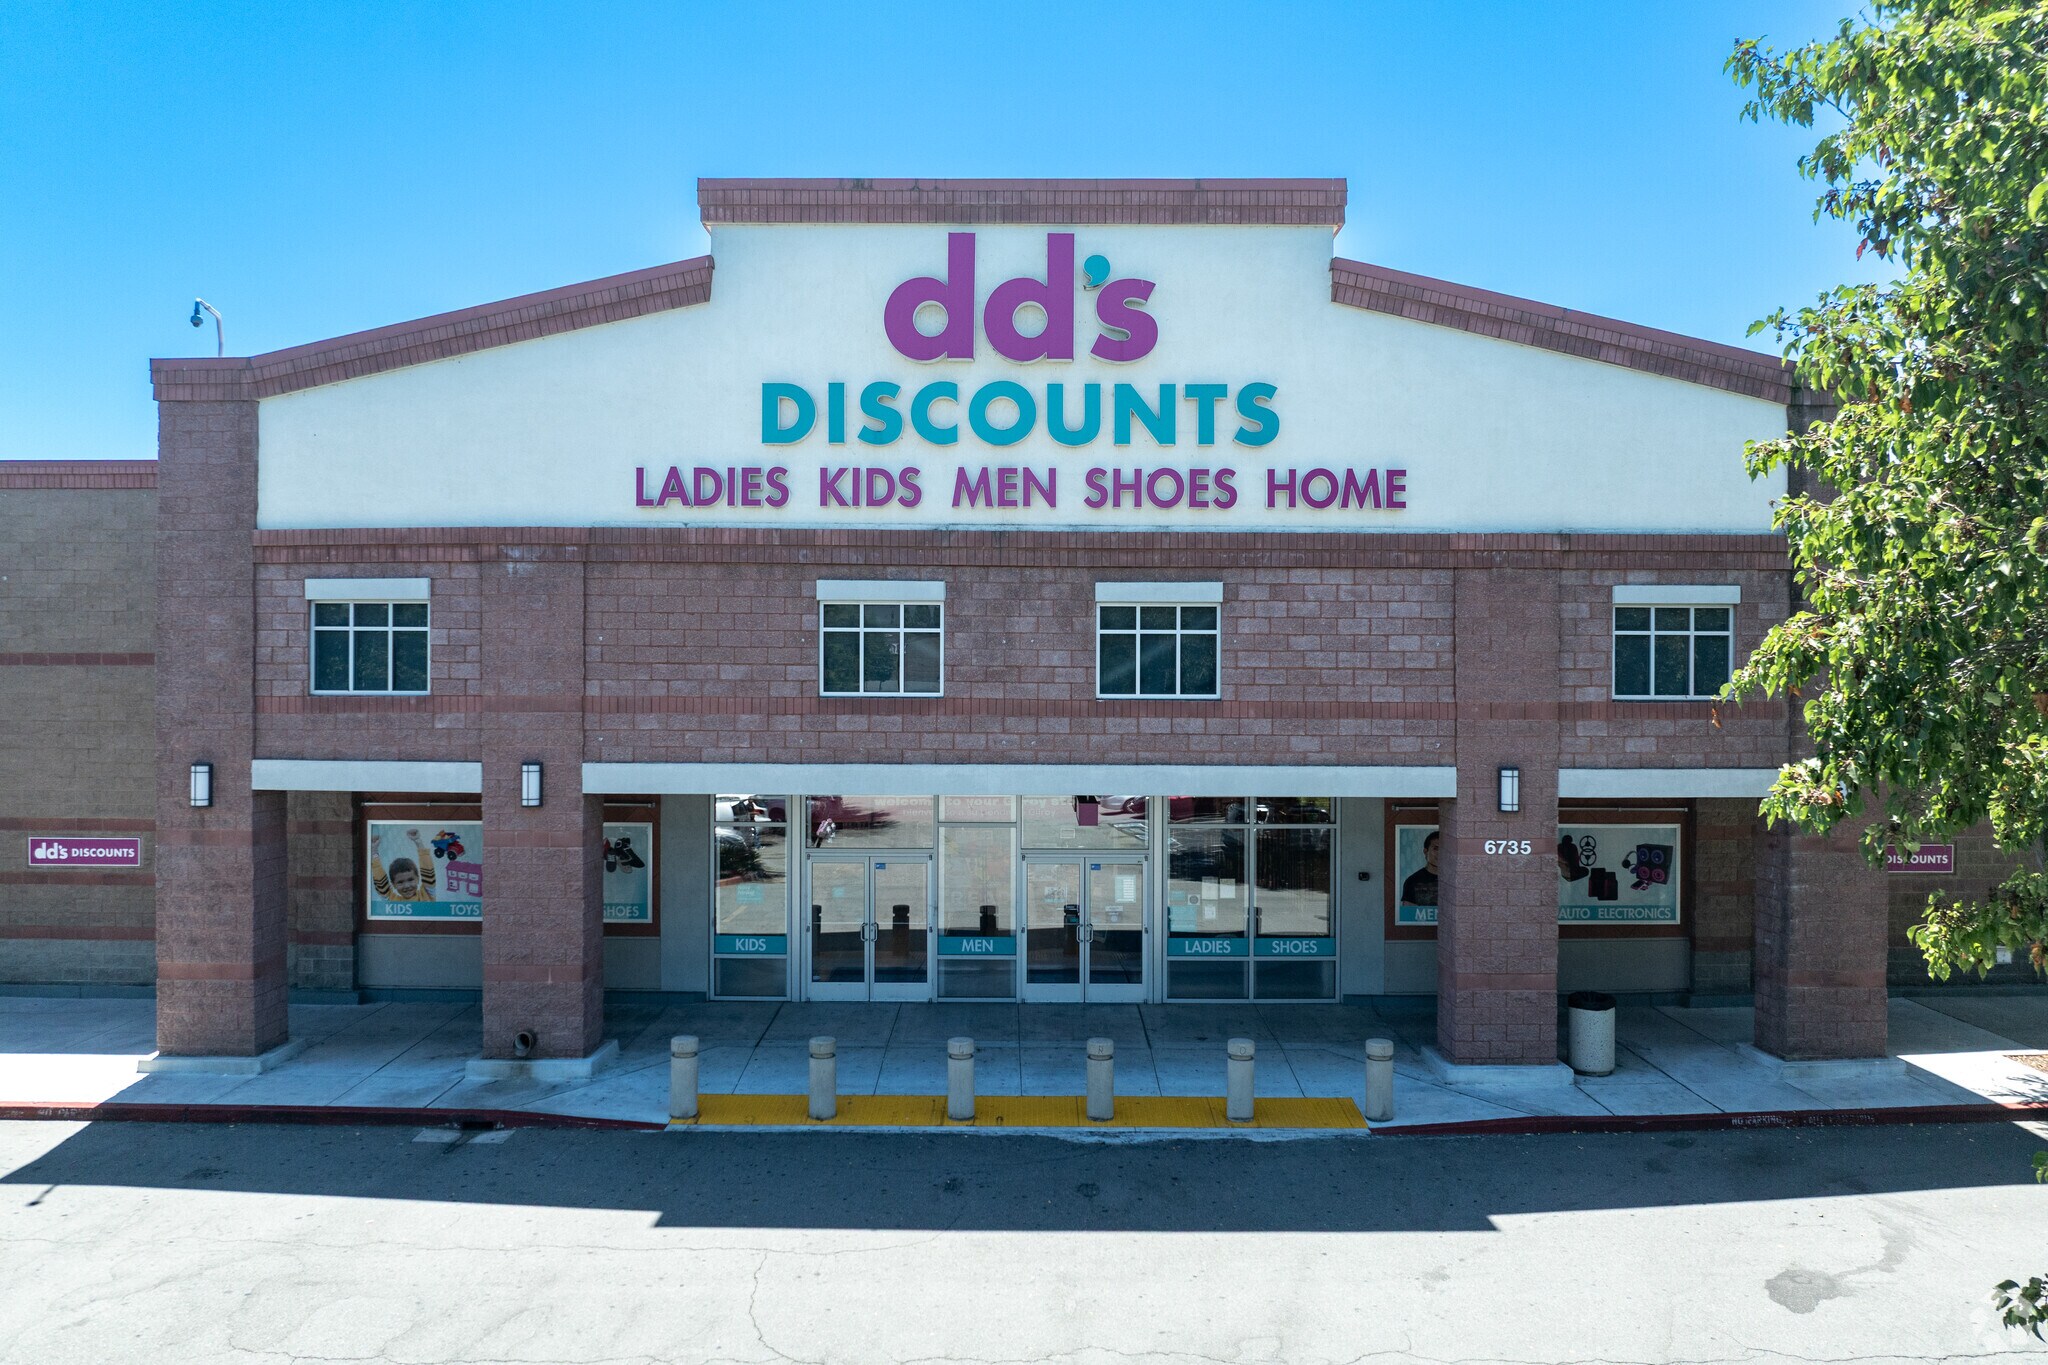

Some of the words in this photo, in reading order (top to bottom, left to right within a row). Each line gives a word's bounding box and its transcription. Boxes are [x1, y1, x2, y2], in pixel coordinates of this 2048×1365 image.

[884, 232, 1159, 364] dd's
[762, 381, 1280, 447] DISCOUNTS
[635, 466, 790, 508] LADIES
[818, 466, 922, 508] KIDS
[952, 467, 1056, 509] MEN
[1085, 466, 1238, 510] SHOES
[1267, 468, 1407, 510] HOME
[874, 797, 934, 806] welcom
[34, 842, 69, 859] dd's
[71, 848, 135, 857] DISCOUNTS
[1484, 840, 1532, 855] 6735
[1887, 855, 1949, 864] DISOUNTS
[385, 903, 413, 915] KIDS
[449, 904, 480, 916] TOYS
[1558, 907, 1591, 919] AUTO
[1598, 907, 1672, 919] ELECTRONICS
[735, 938, 767, 951] KIDS
[961, 938, 994, 952] MEN
[1185, 940, 1231, 953] LADIES
[1271, 940, 1317, 954] SHOES
